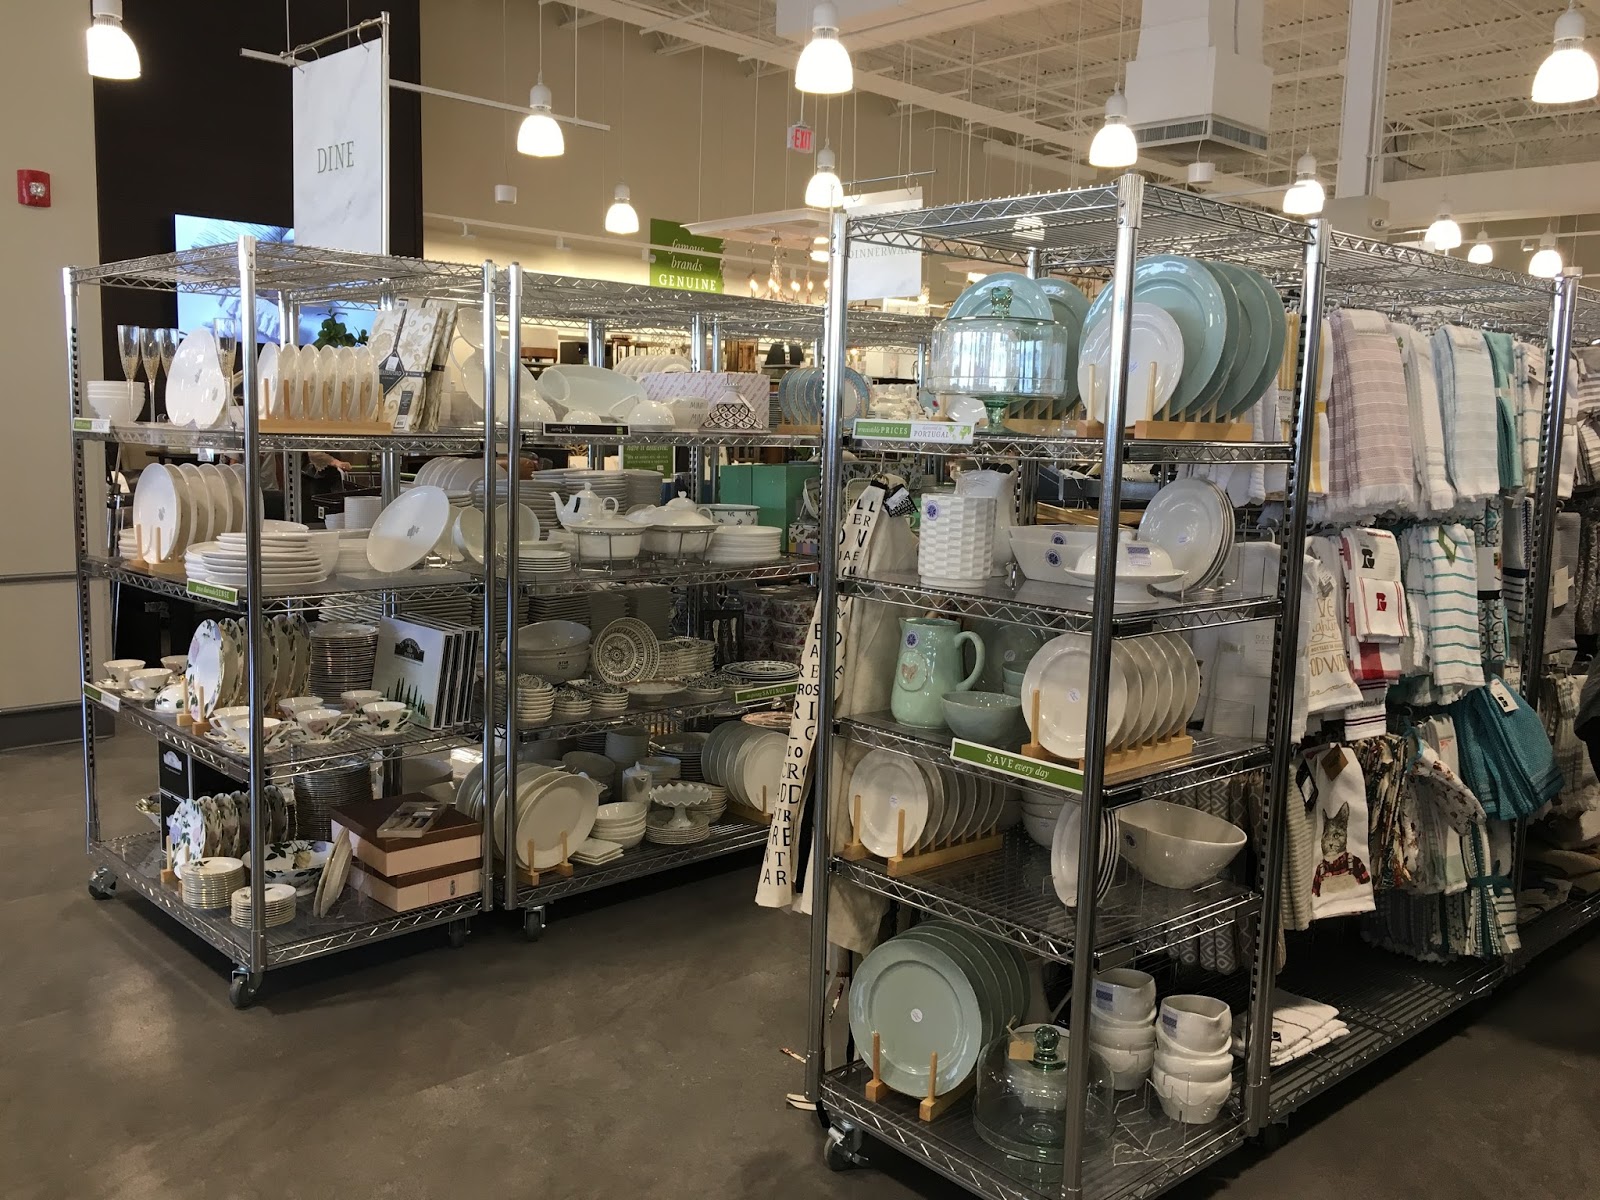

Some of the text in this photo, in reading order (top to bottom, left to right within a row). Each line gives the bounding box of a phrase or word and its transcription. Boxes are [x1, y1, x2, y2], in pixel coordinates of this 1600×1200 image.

[794, 128, 812, 150] EXIT
[317, 141, 354, 174] DINE
[671, 255, 703, 272] brands
[659, 273, 717, 291] GENUINE
[880, 426, 908, 435] PRICES
[913, 430, 949, 438] PORTUGAL
[762, 687, 787, 696] SAVINGS
[986, 753, 1050, 780] SAVE every day
